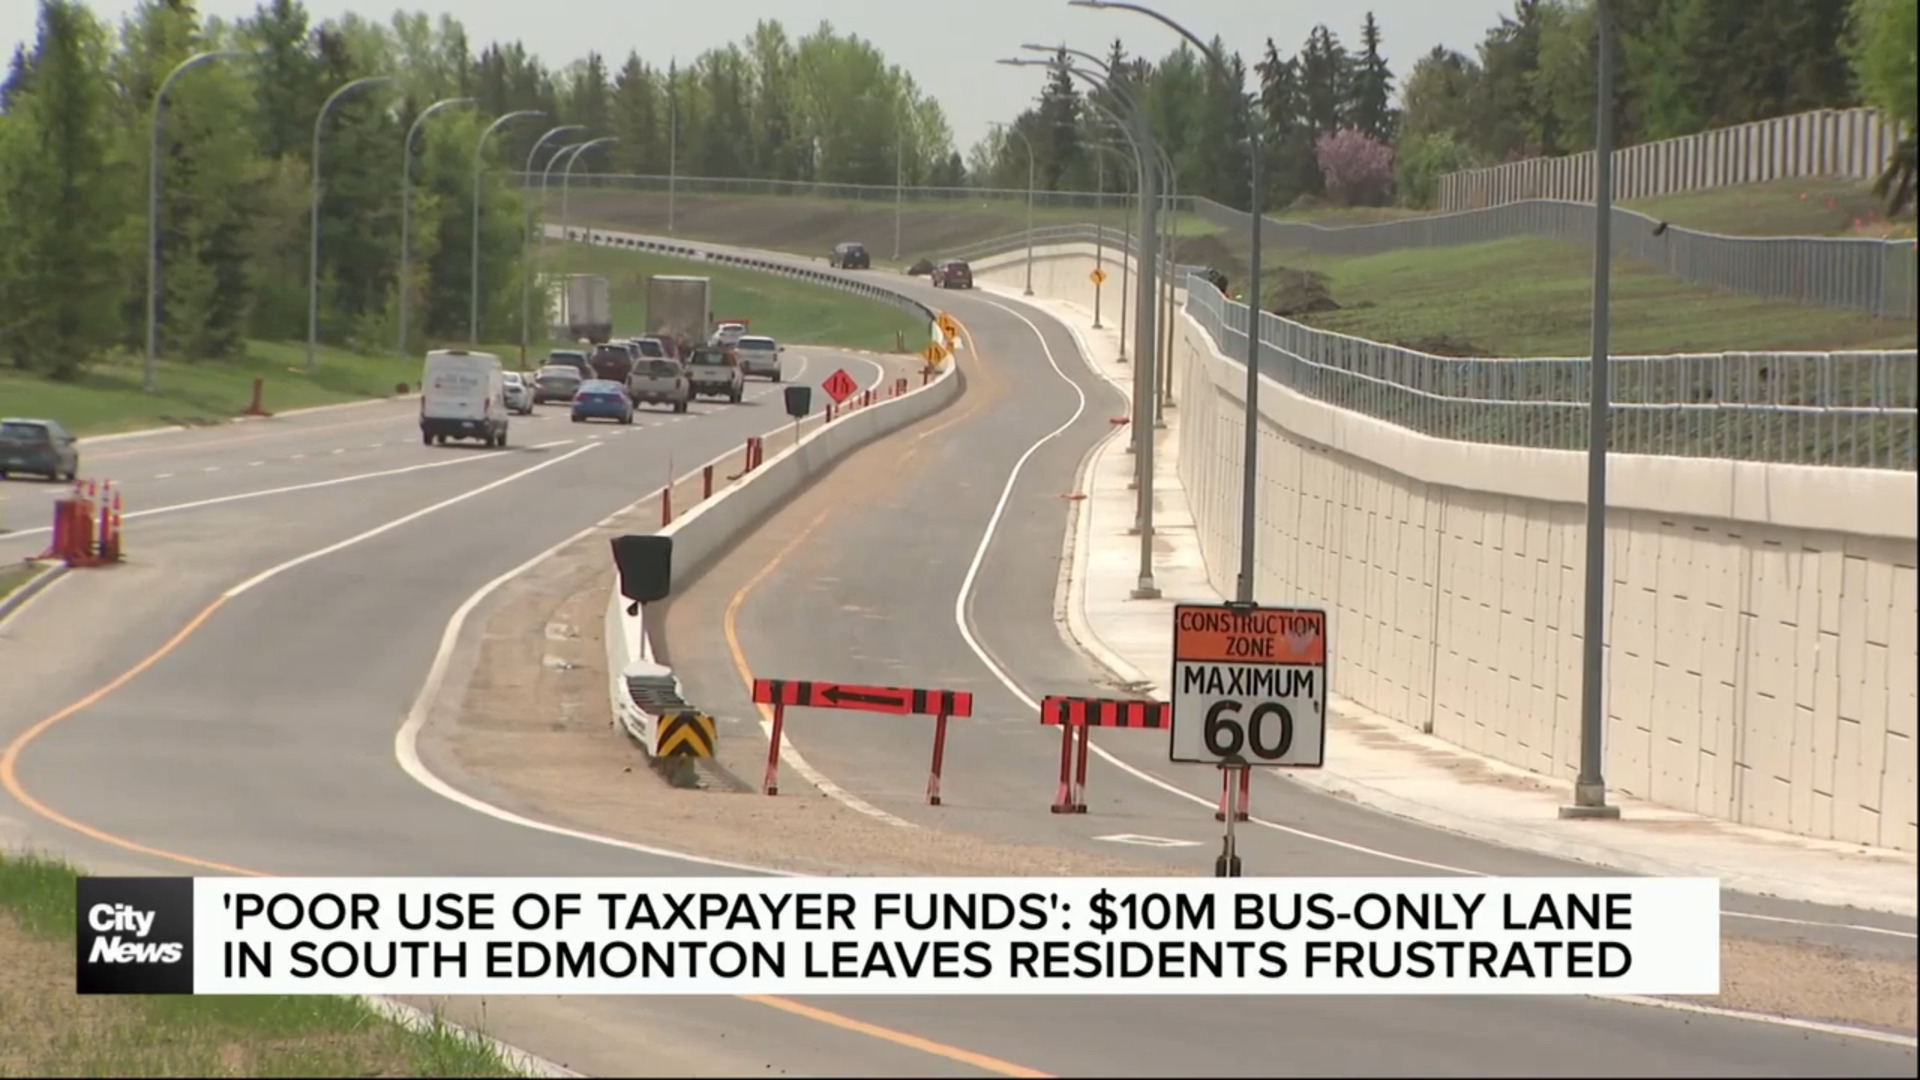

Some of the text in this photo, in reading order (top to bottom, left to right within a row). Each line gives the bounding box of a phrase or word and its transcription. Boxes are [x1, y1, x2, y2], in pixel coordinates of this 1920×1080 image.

[1180, 611, 1320, 636] CONSTRUCTION
[1226, 636, 1275, 657] ZONE
[1184, 666, 1314, 698] MAXIMUM
[1204, 700, 1294, 760] 60
